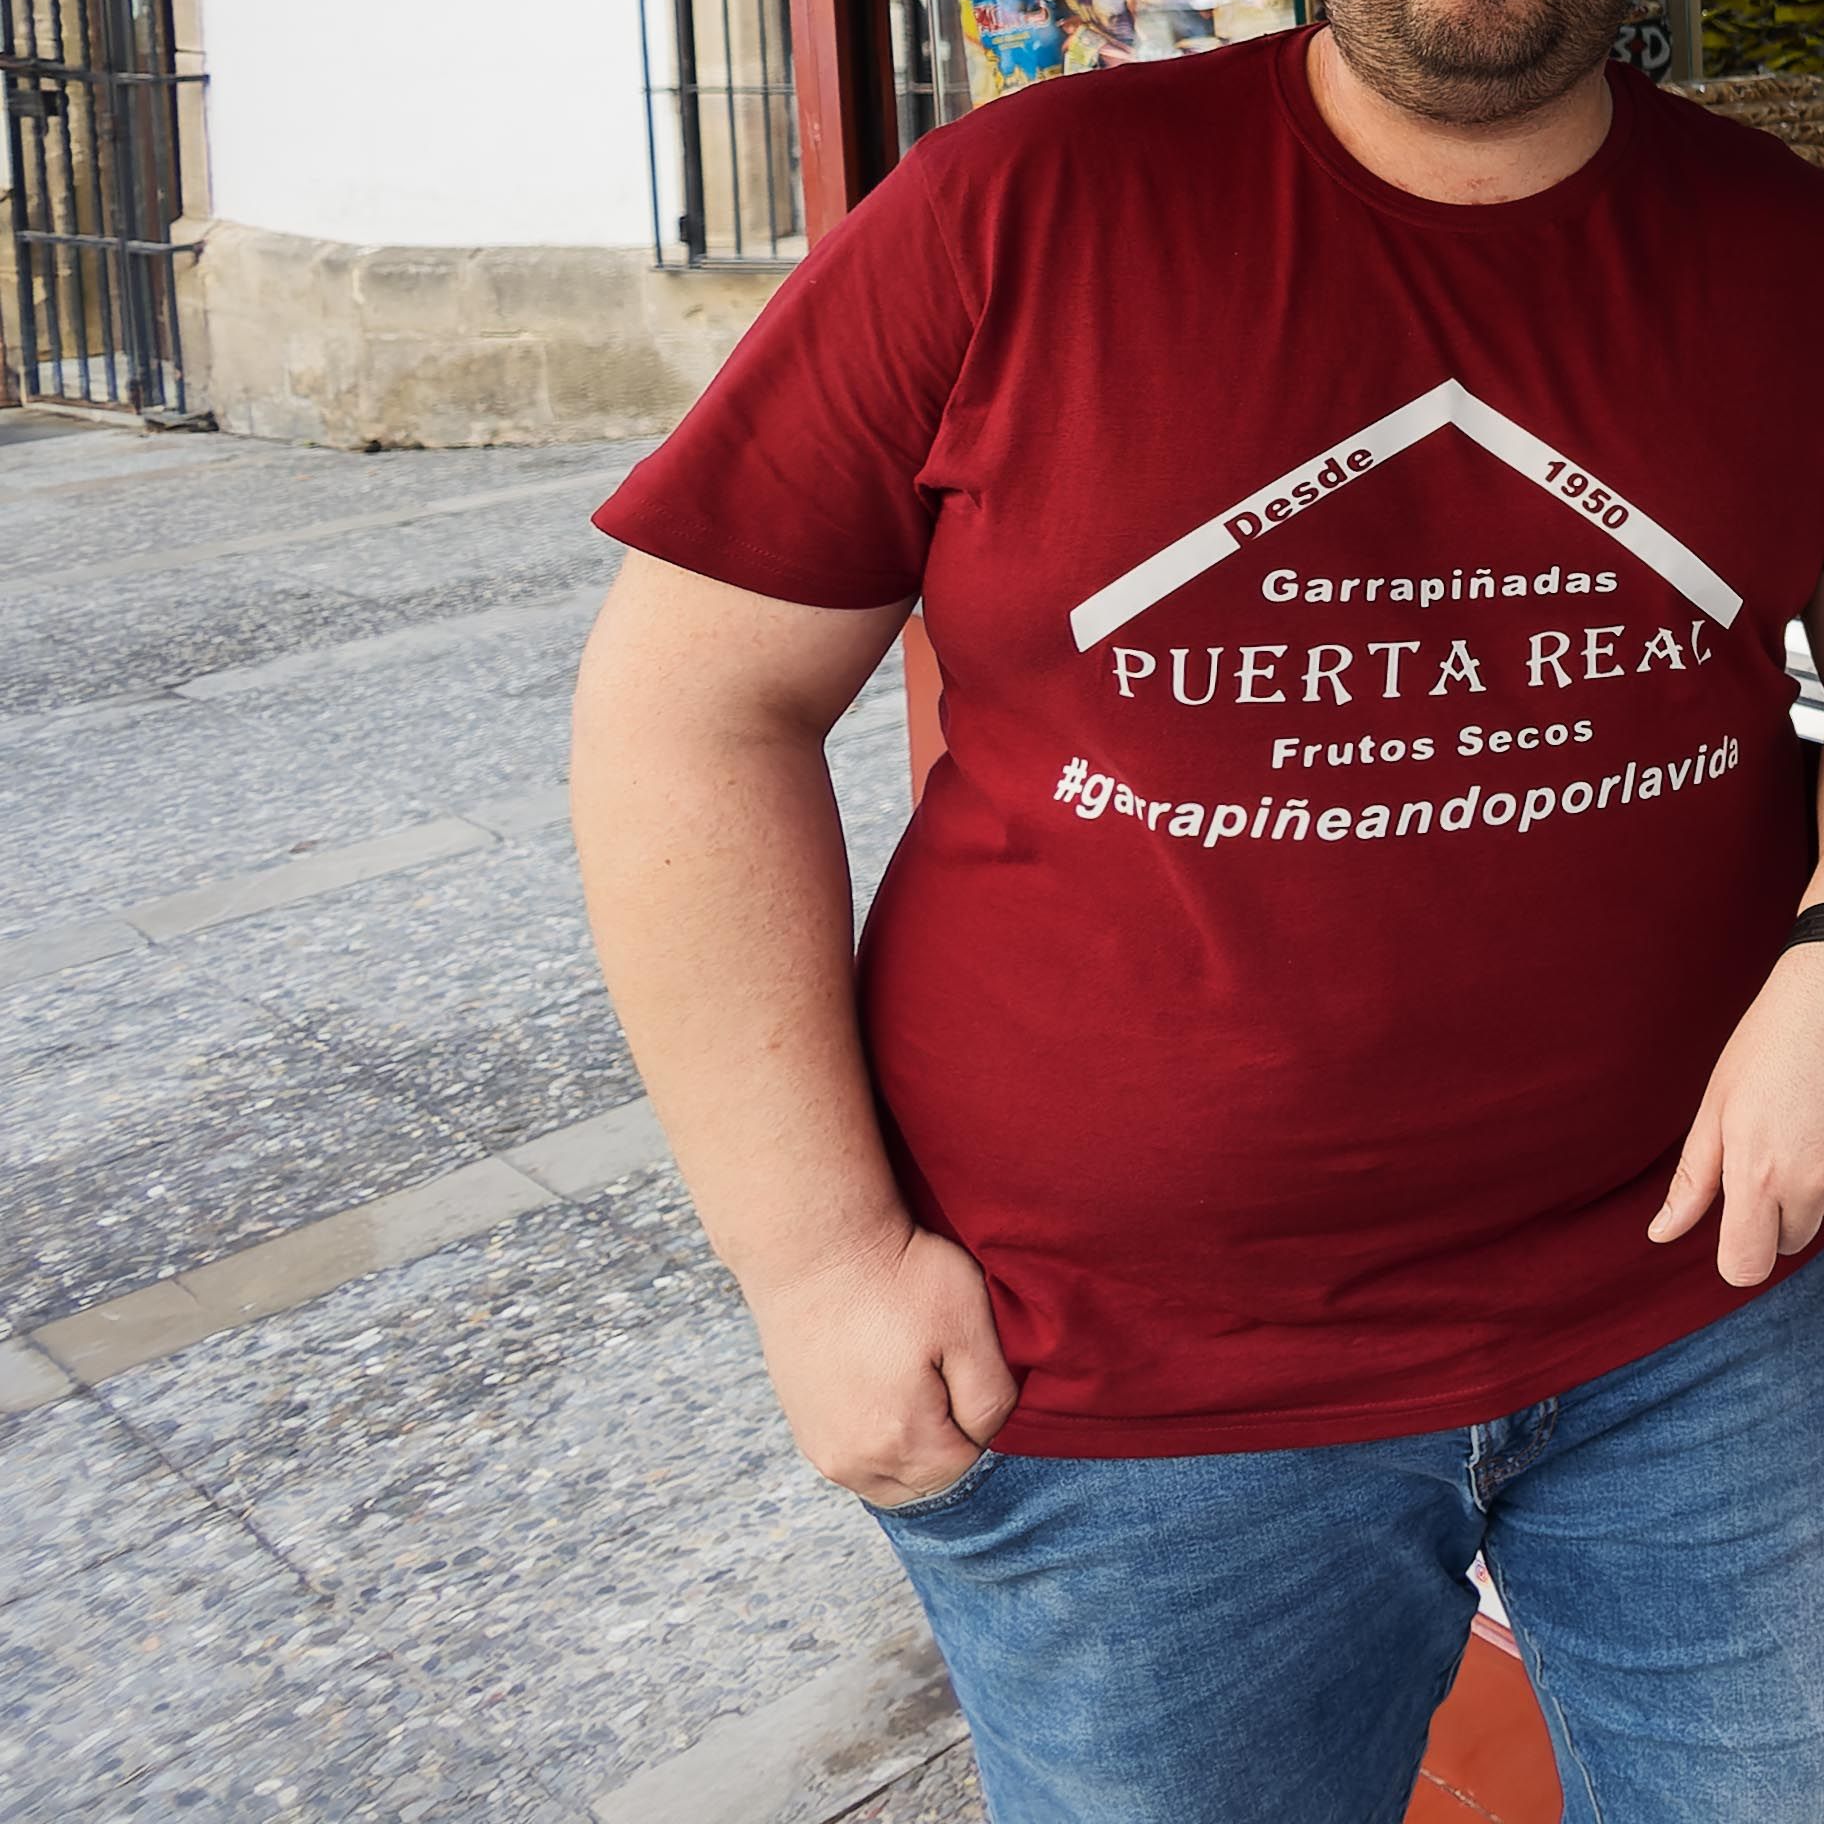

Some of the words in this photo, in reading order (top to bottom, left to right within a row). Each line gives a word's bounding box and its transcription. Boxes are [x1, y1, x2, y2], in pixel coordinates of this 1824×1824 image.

[1223, 444, 1374, 549] Desde
[1545, 459, 1630, 531] 1950
[1262, 565, 1618, 607] Garrapiñadas
[1112, 638, 1487, 706] PUERTA
[1526, 619, 1712, 689] REAL
[1272, 732, 1434, 769] Frutos
[1457, 719, 1593, 758] Secos
[1052, 734, 1740, 848] #garrapiñeandoporlavida
